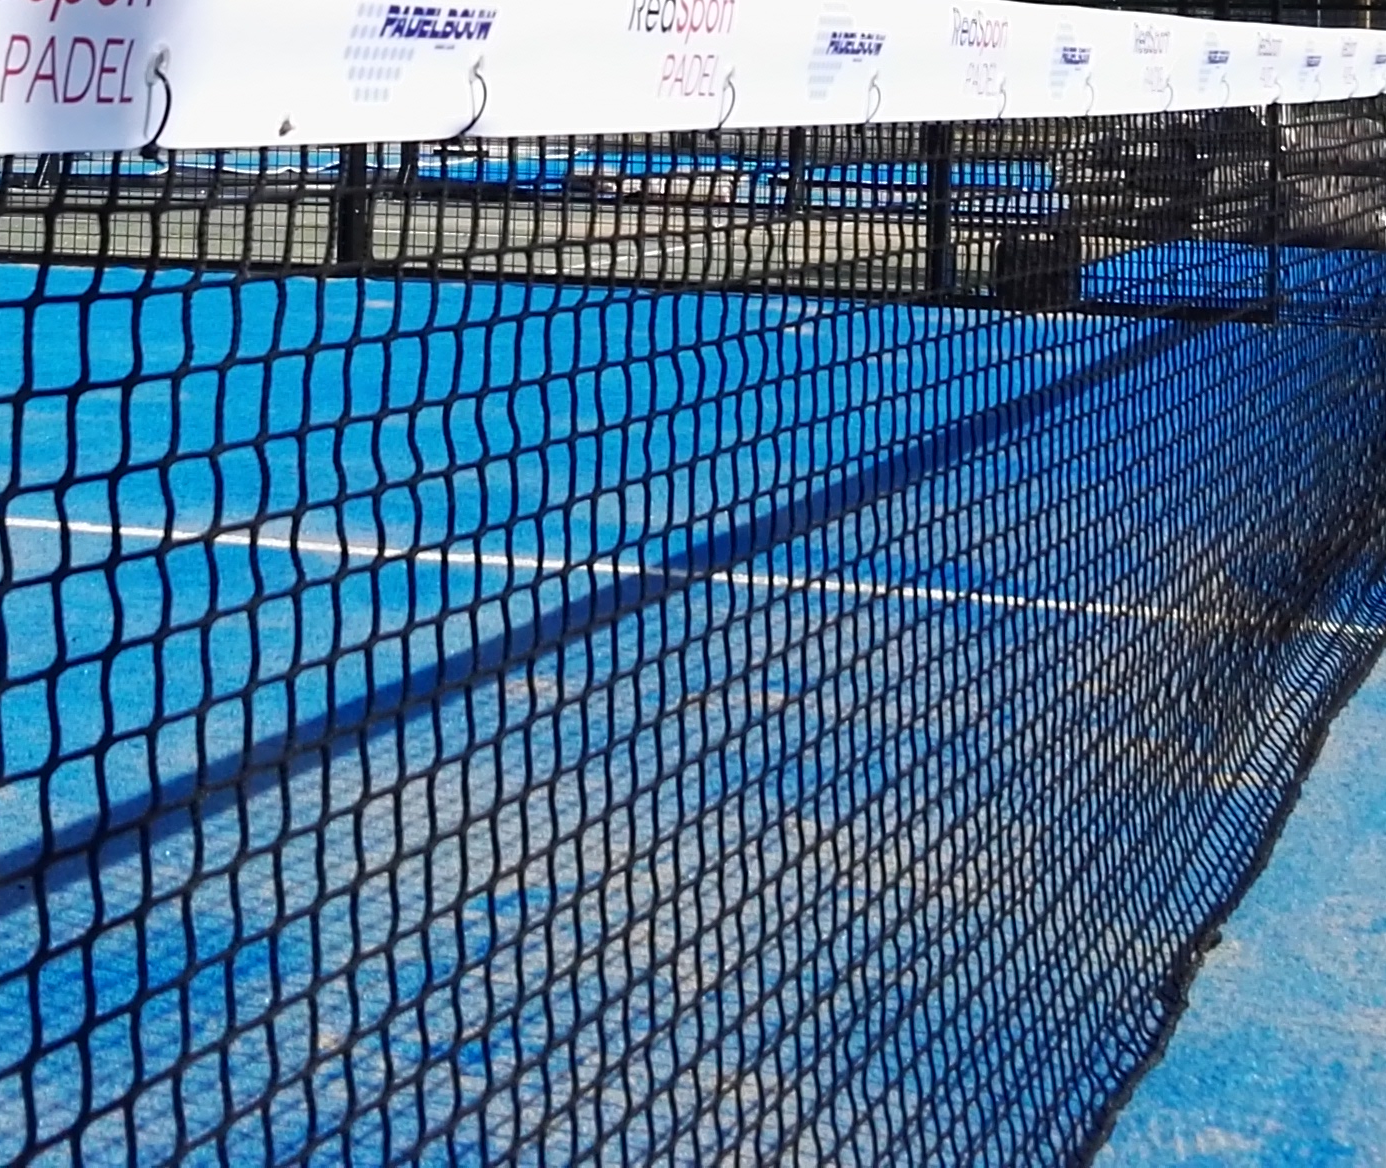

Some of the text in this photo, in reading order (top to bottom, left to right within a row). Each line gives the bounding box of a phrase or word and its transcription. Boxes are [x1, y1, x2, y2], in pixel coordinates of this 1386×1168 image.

[379, 4, 497, 40] PADELBOUW
[0, 34, 134, 104] PADEL
[657, 54, 718, 97] PADEL
